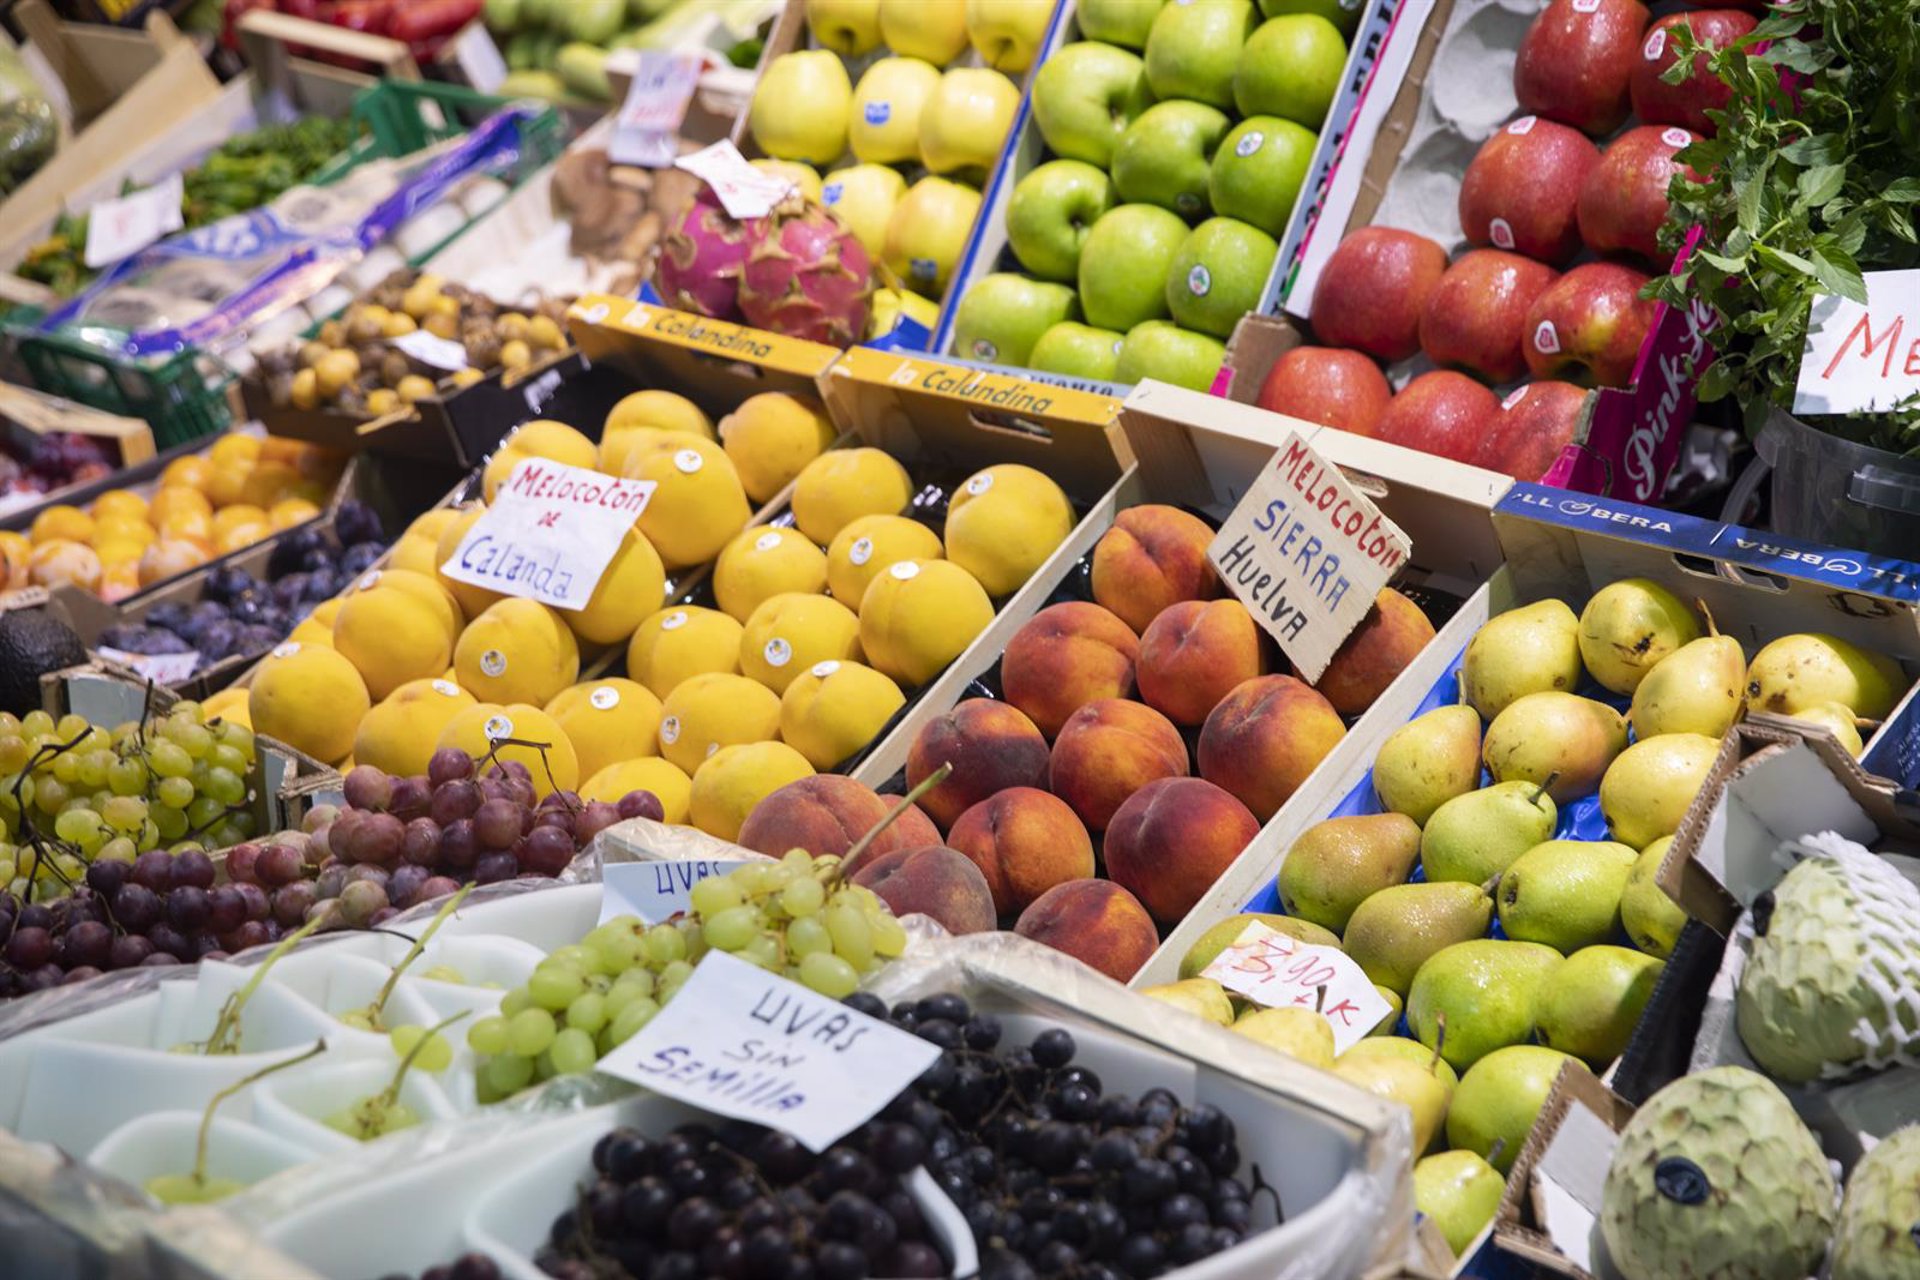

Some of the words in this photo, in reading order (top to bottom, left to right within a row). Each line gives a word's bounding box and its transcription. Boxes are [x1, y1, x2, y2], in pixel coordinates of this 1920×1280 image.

[653, 313, 773, 358] Calandina
[921, 369, 1053, 414] Calandina
[1624, 353, 1687, 500] Pink
[461, 535, 573, 599] Calanda
[1232, 940, 1336, 987] 3,90
[750, 986, 869, 1052] UVAS
